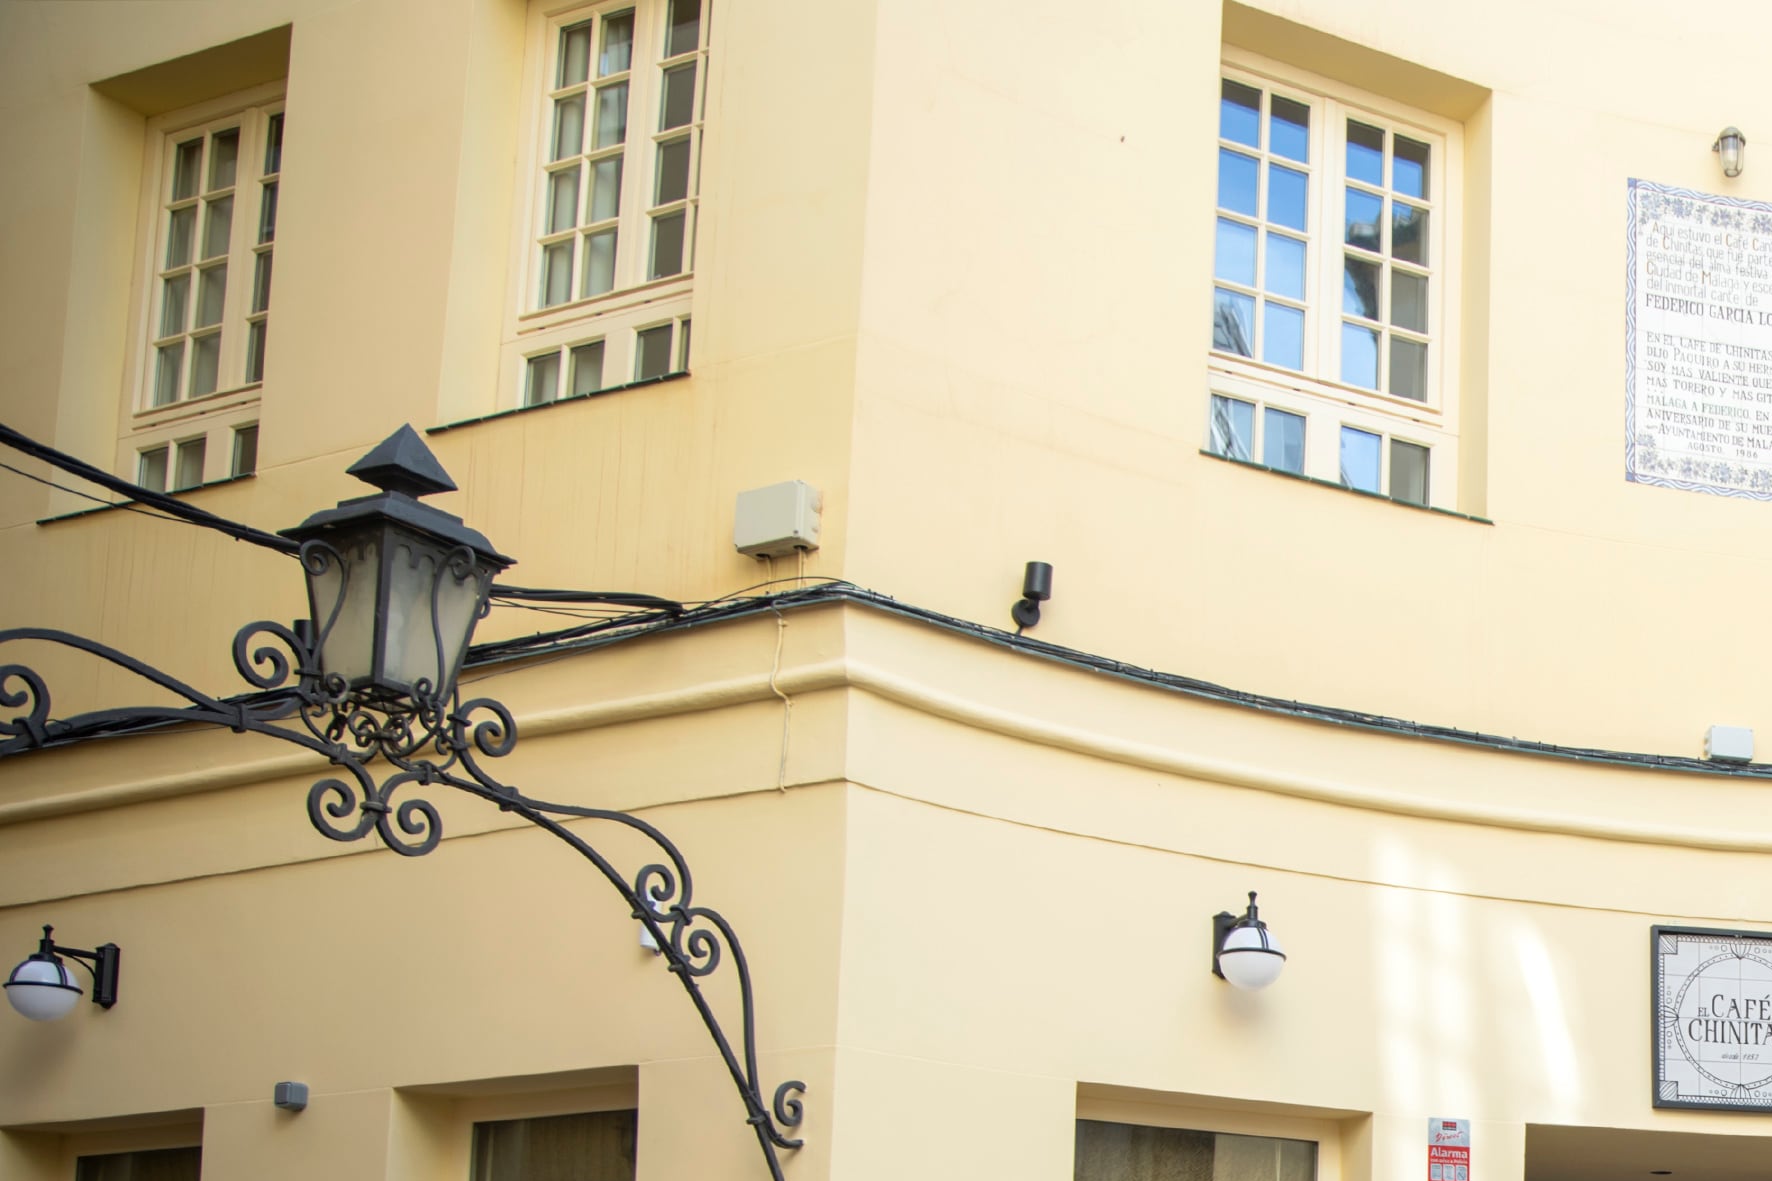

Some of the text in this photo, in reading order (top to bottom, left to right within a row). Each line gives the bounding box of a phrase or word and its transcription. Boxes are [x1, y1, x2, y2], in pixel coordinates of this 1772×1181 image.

[1646, 234, 1658, 247] de
[1706, 248, 1724, 260] que
[1678, 227, 1711, 243] estuvo
[1714, 233, 1722, 244] el
[1646, 251, 1685, 266] esencial
[1689, 256, 1703, 269] del
[1709, 258, 1730, 274] alma
[1736, 263, 1768, 279] festiva
[1647, 261, 1681, 280] Ciudad
[1685, 269, 1698, 282] de
[1744, 281, 1749, 291] y
[1647, 276, 1758, 306] del inmortal cante de
[1646, 293, 1704, 316] FEDERICO
[1647, 331, 1660, 342] EN
[1663, 334, 1675, 346] EL
[1710, 342, 1721, 353] DE
[1647, 346, 1668, 359] DIJO
[1674, 347, 1719, 368] PAQUIRO
[1724, 359, 1729, 370] A
[1733, 361, 1745, 371] SU
[1673, 379, 1714, 397] TORERO
[1719, 387, 1727, 397] Y
[1699, 369, 1749, 386] VALIENTE
[1752, 377, 1772, 389] QUE
[1647, 408, 1714, 428] ANIVERSARIO
[1719, 419, 1730, 430] DE
[1736, 422, 1748, 433] SU
[1692, 401, 1698, 412] A
[1756, 410, 1769, 422] EN
[1658, 423, 1729, 444] AYUNTAMIENTO
[1732, 435, 1744, 447] DE
[1736, 449, 1758, 458] 1986
[1697, 1007, 1710, 1017] EL
[1712, 994, 1771, 1021] CAFÉ
[1431, 1147, 1467, 1159] Alarma
